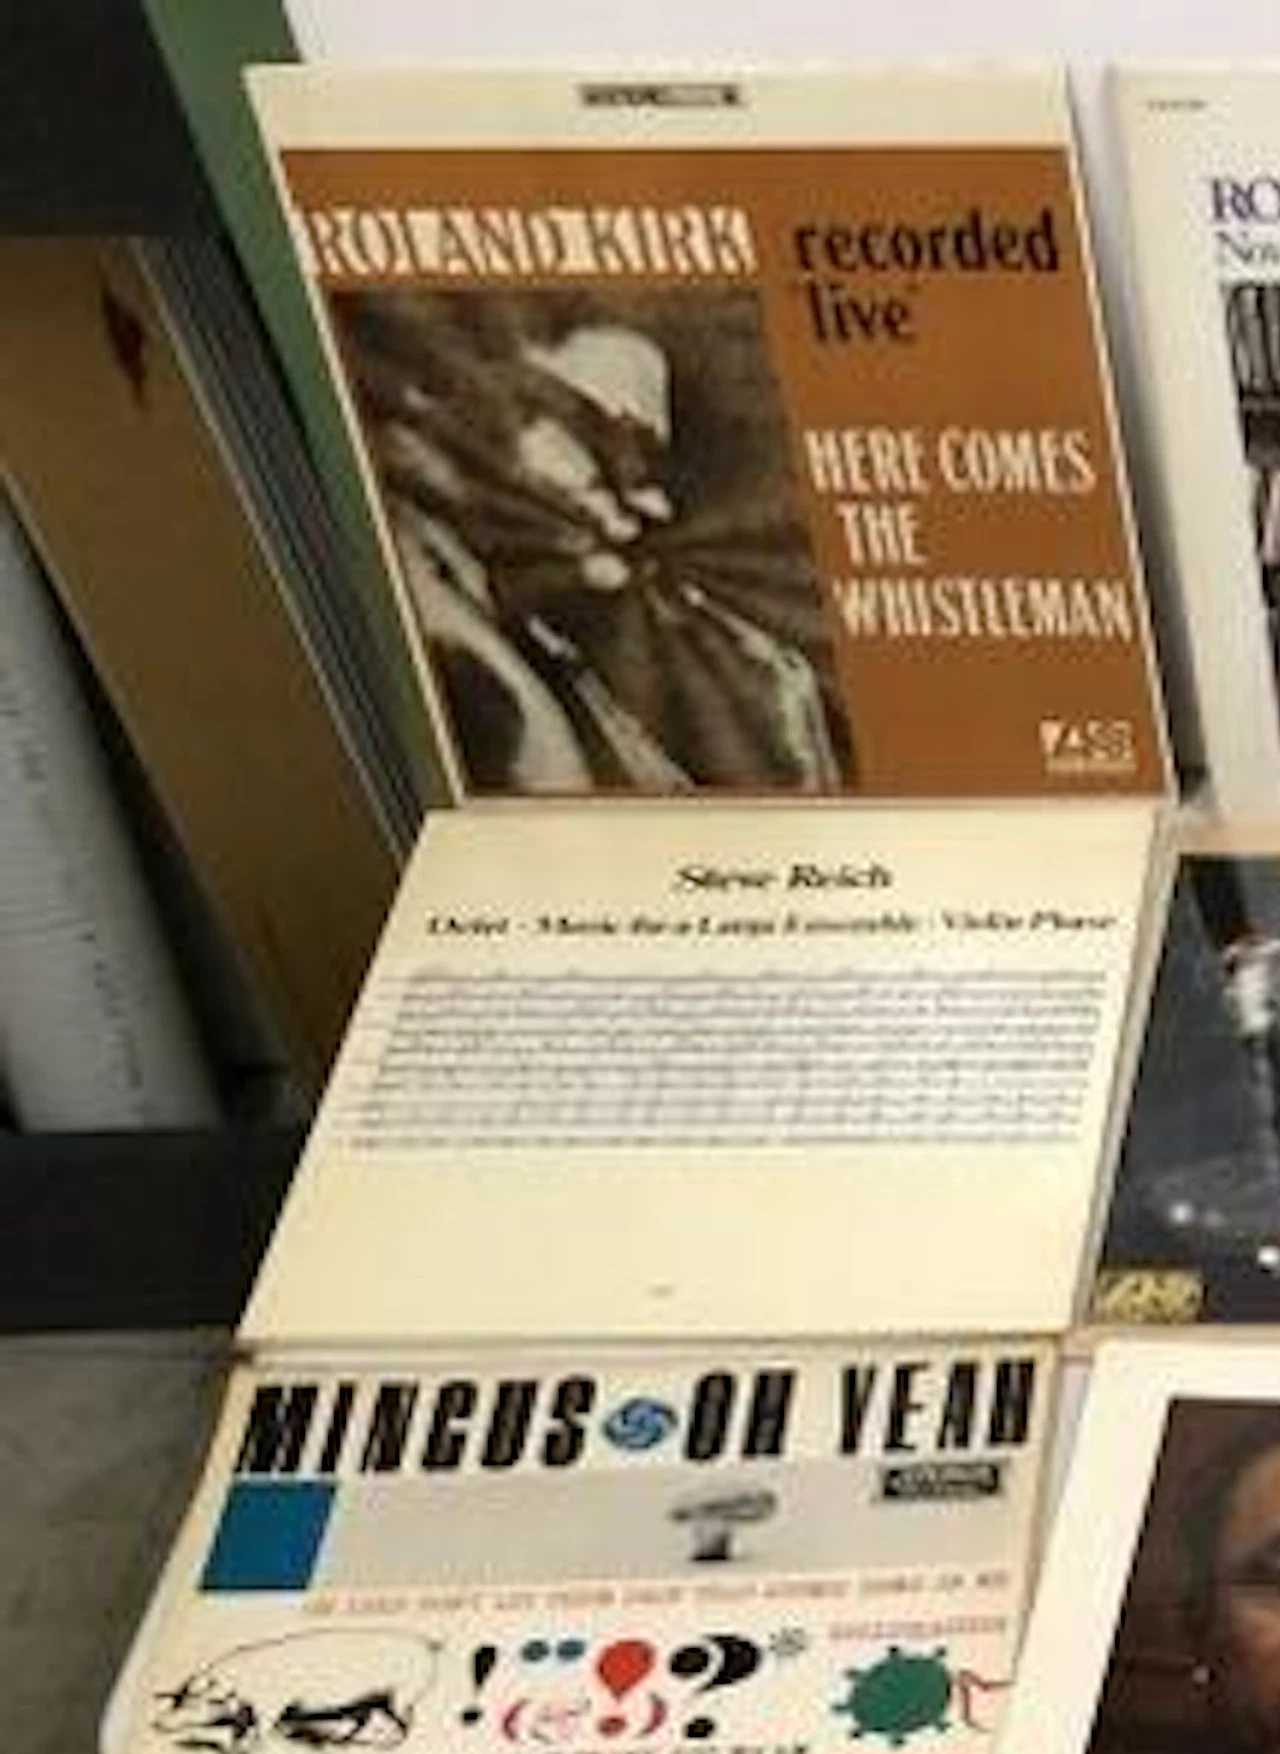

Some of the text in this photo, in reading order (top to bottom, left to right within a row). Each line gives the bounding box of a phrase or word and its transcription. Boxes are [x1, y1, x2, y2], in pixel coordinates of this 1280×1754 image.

[306, 203, 758, 278] ROLAND KIRK
[793, 206, 1060, 274] recorded
[803, 427, 1097, 495] HERE COMES
[836, 502, 929, 566] THE
[832, 576, 1135, 642] WHISTLEMAN
[233, 1358, 1036, 1476] MINGUS OH YEAH
